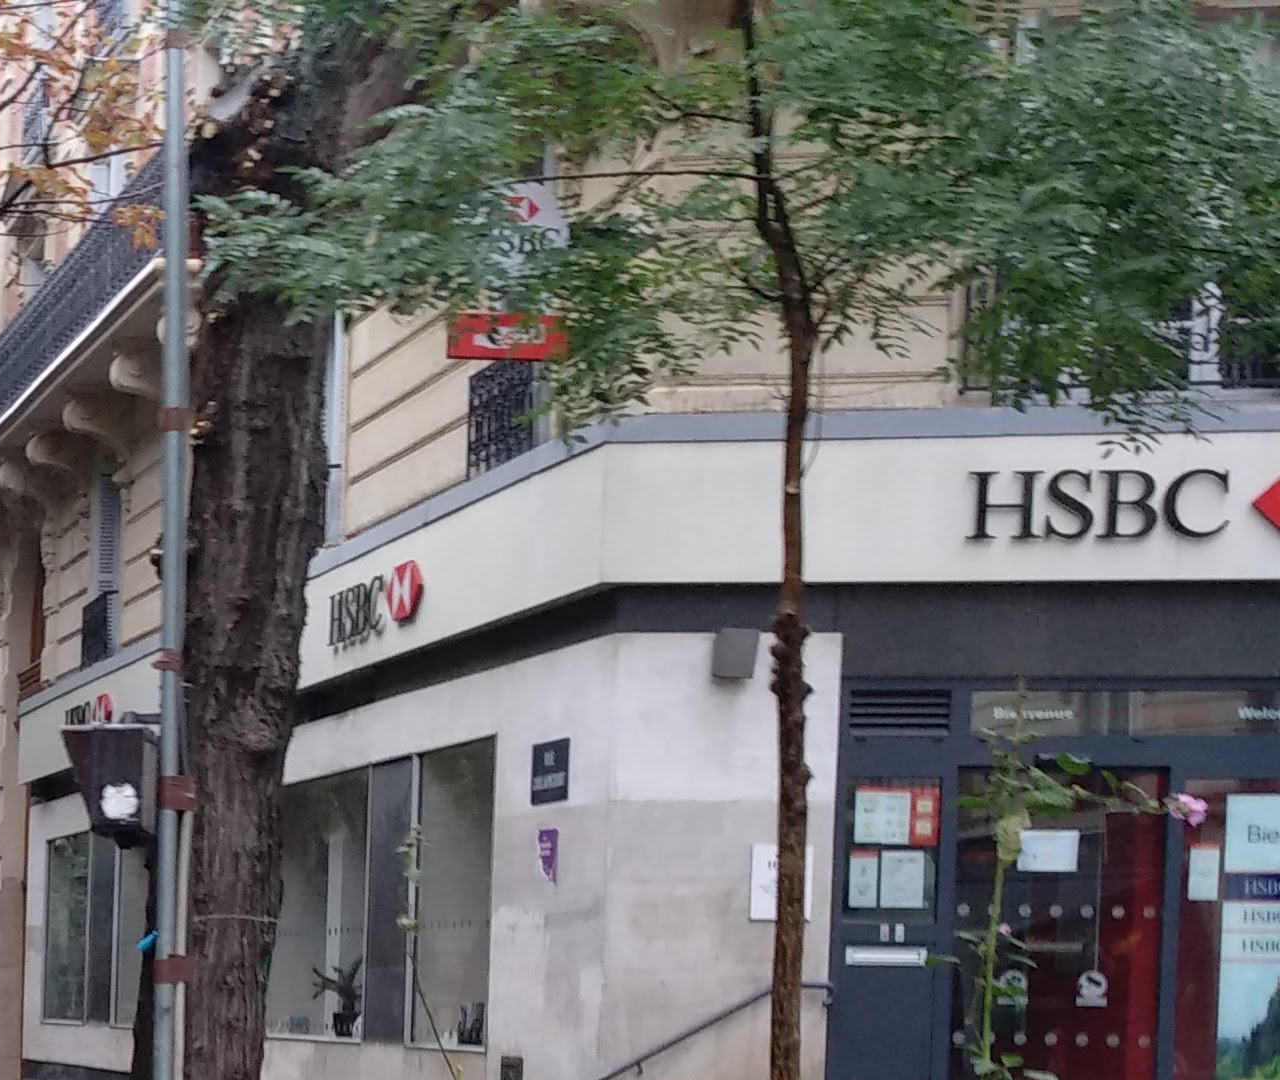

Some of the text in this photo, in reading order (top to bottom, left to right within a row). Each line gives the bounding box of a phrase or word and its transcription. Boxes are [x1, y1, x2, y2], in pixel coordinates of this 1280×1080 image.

[965, 469, 1230, 540] HSBC
[327, 574, 385, 647] HSBC
[1243, 880, 1280, 895] HSB
